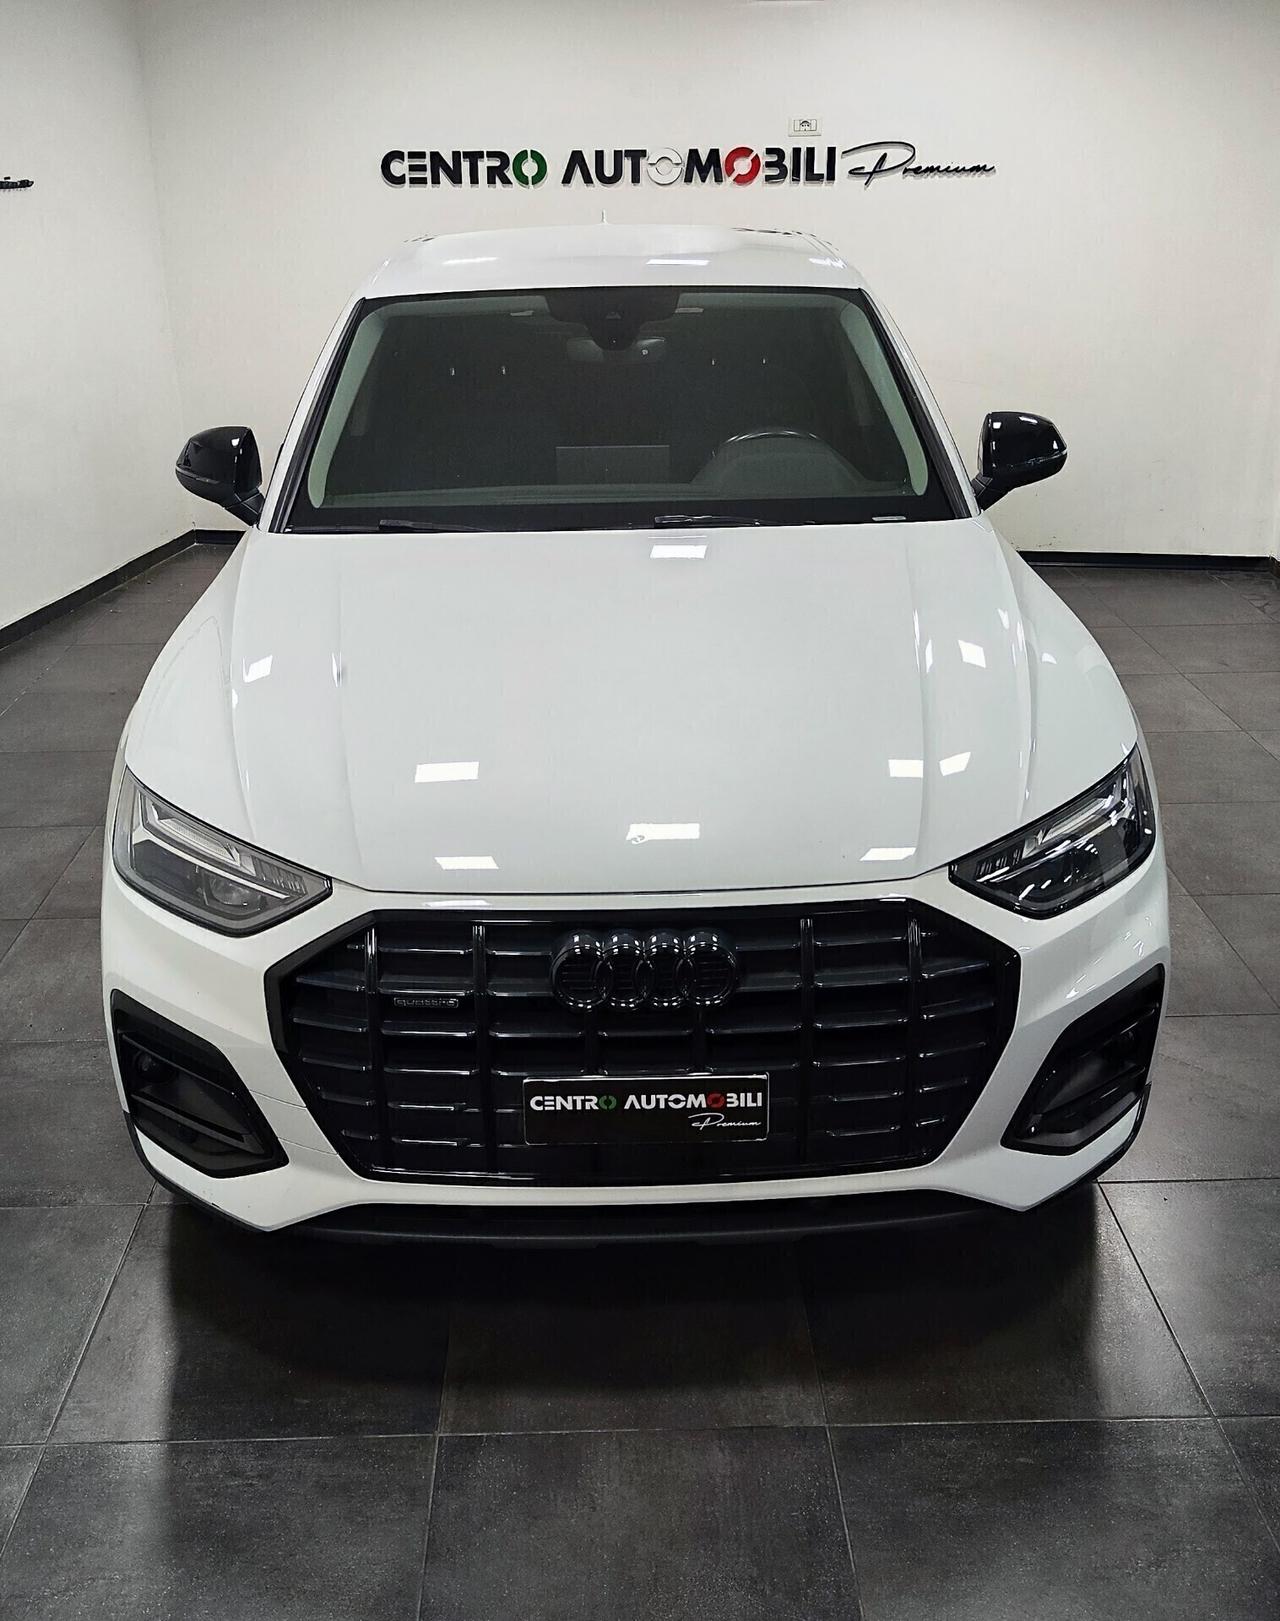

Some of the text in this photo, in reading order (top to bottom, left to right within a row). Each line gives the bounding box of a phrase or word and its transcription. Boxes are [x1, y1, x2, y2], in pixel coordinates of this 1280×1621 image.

[381, 141, 996, 188] CENTRO AUTOMOBILI Premium
[530, 1092, 763, 1111] CENTRO AUTOMOBILI
[688, 1112, 761, 1130] Premium
